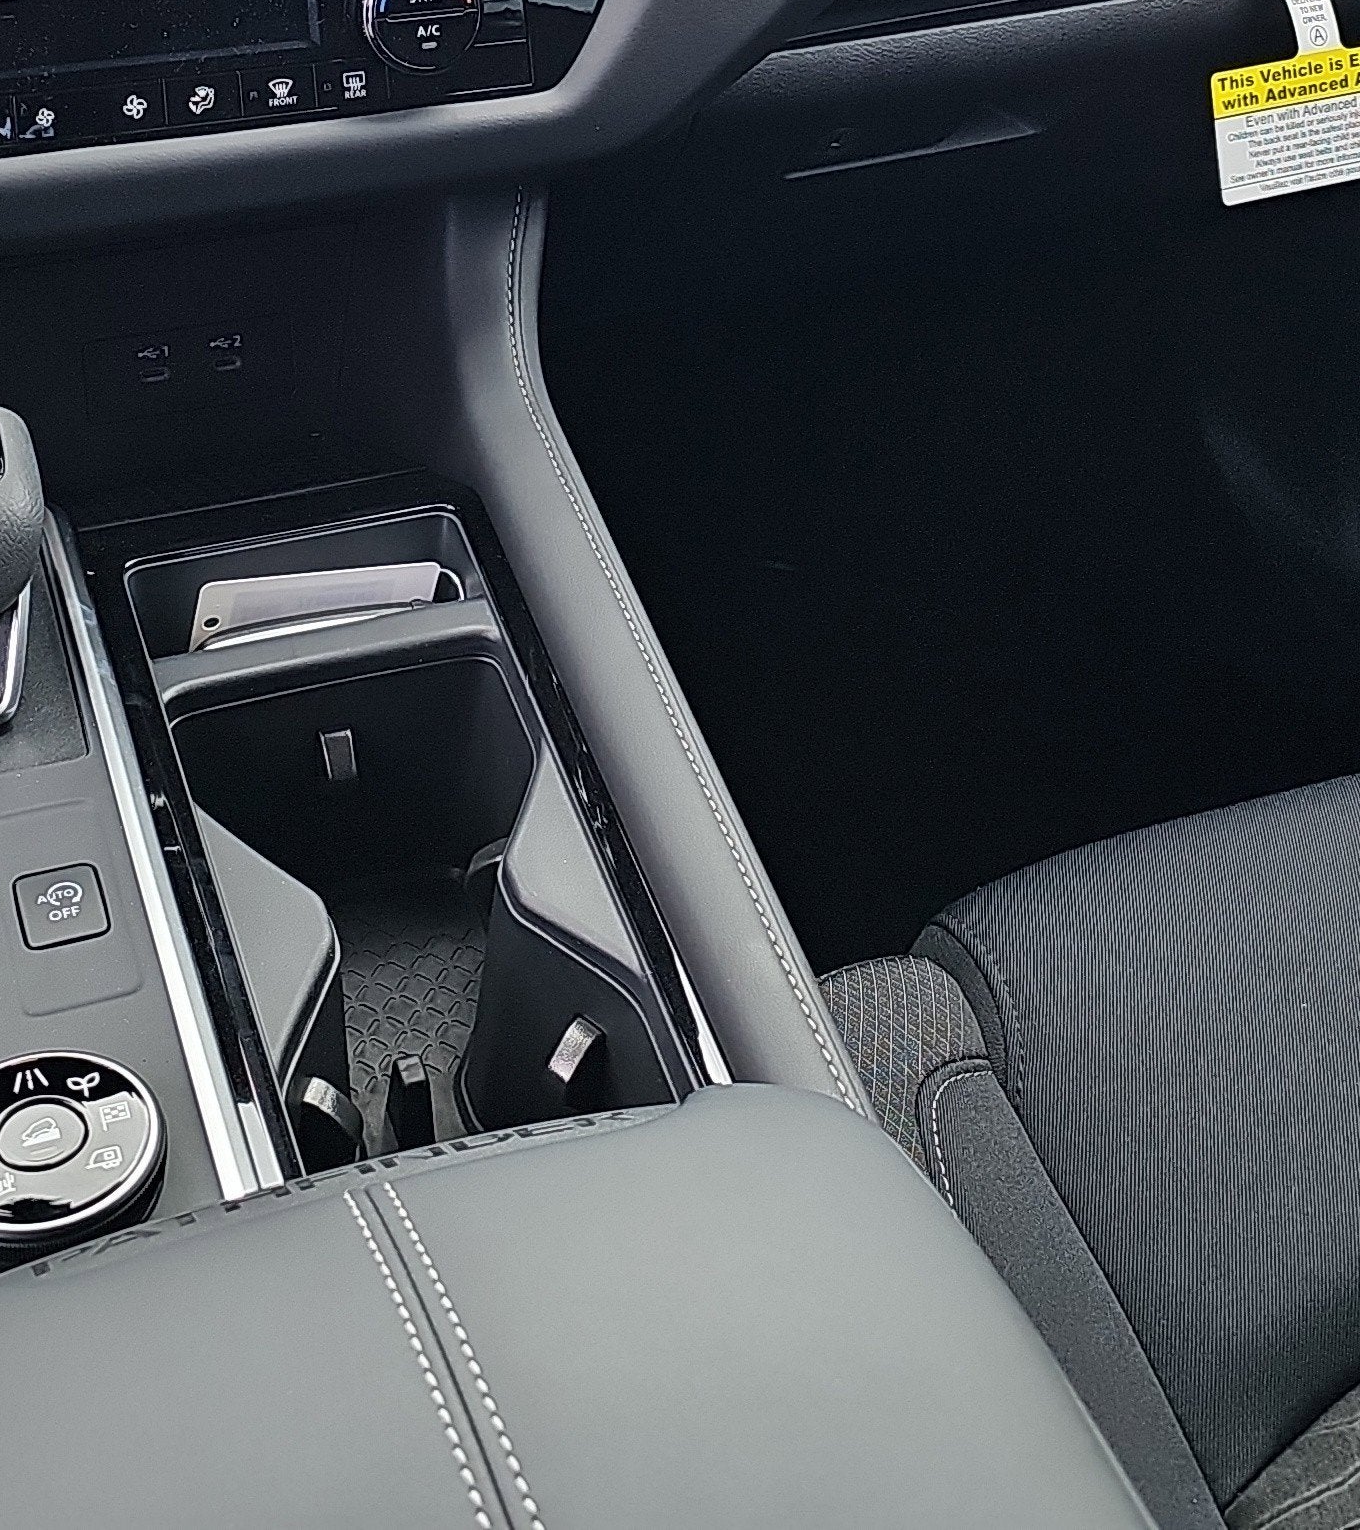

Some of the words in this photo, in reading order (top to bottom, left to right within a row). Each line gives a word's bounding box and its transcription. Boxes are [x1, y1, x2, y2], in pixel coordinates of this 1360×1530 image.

[1299, 6, 1308, 14] TO
[416, 24, 441, 38] A/C
[1218, 74, 1254, 92] This
[1260, 62, 1324, 84] Vehicle
[1328, 58, 1344, 72] is
[268, 92, 298, 107] FRONT
[344, 86, 367, 100] REAR
[1222, 92, 1260, 110] with
[1264, 74, 1348, 104] Advanced
[1246, 114, 1274, 128] Even
[1276, 108, 1300, 122] with
[1302, 96, 1358, 118] Advanced
[48, 905, 81, 921] OFF
